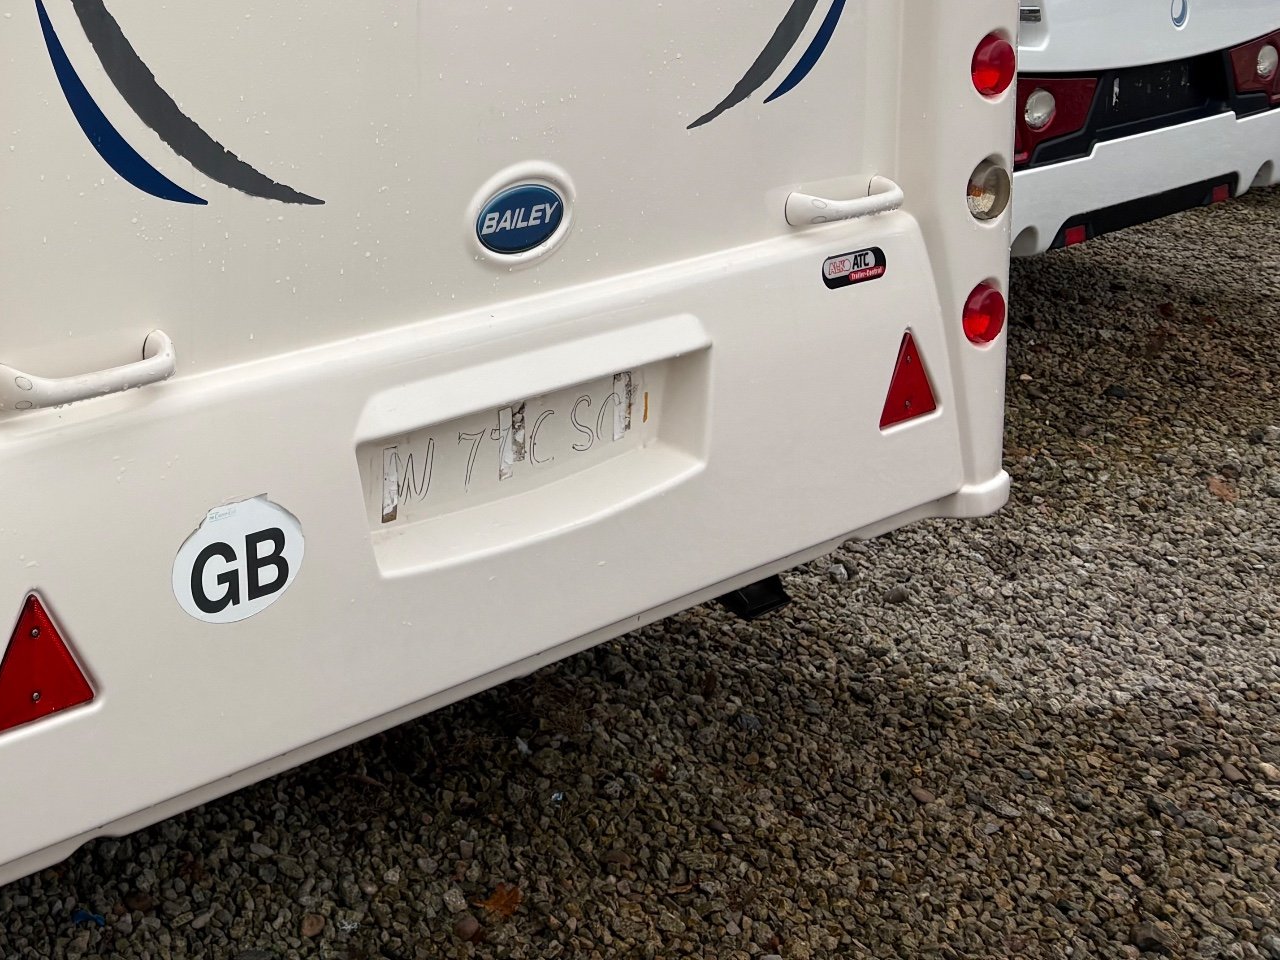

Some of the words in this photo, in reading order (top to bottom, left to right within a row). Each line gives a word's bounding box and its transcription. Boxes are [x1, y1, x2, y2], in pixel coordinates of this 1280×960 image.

[480, 201, 559, 235] BAILEY
[852, 251, 870, 270] ATC
[190, 527, 290, 614] GB
